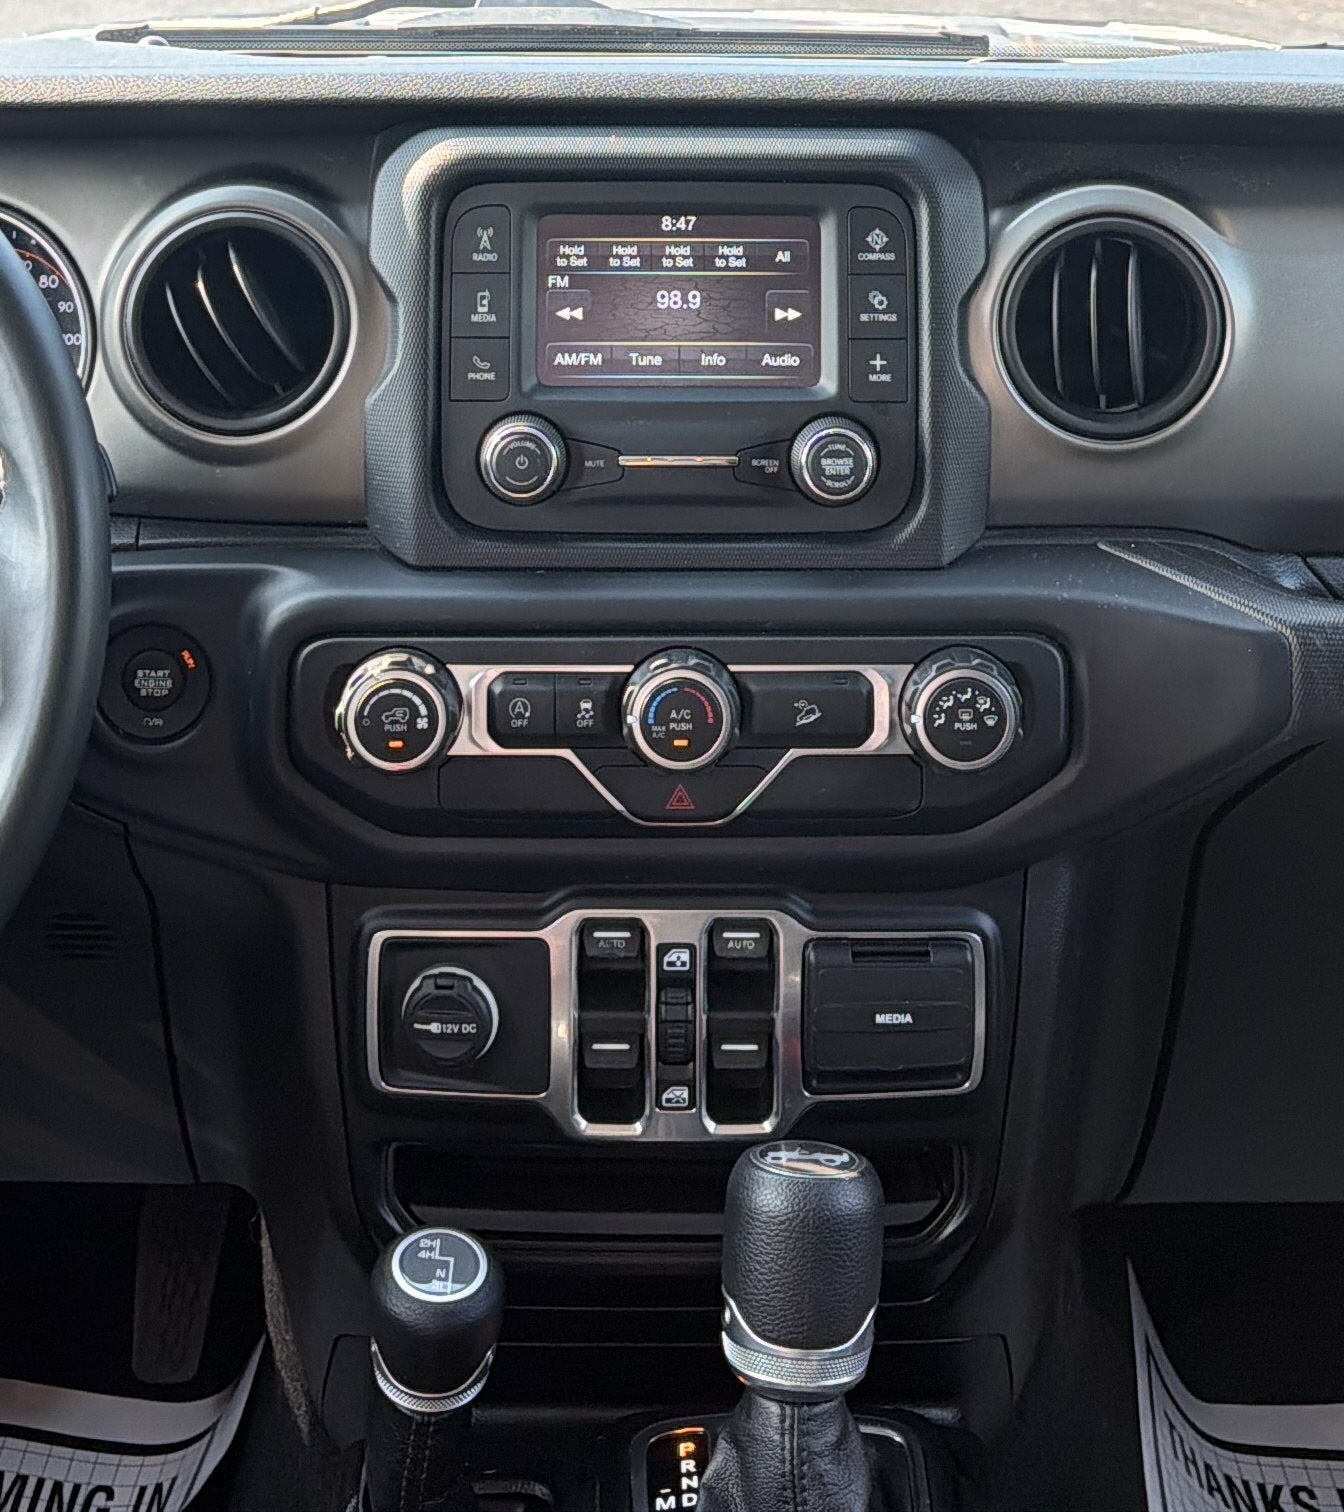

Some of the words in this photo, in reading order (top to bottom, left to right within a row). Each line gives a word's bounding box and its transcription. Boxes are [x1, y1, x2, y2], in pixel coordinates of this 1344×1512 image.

[661, 216, 697, 231] 8:47
[559, 244, 585, 255] Hold
[612, 244, 638, 255] Hold
[665, 244, 691, 255] Hold
[718, 244, 744, 255] Hold
[472, 252, 498, 262] RADIO
[775, 250, 791, 263] All
[857, 252, 896, 261] COMPASS
[556, 257, 568, 267] to
[569, 257, 588, 267] Set
[609, 257, 621, 267] to
[622, 257, 641, 267] Set
[662, 257, 674, 267] to
[675, 257, 694, 267] Set
[715, 257, 727, 267] to
[728, 257, 747, 267] Set
[38, 275, 59, 289] 80
[547, 275, 570, 288] FM
[656, 290, 701, 310] 98.9
[57, 301, 74, 313] 90
[470, 313, 497, 323] MEDIA
[859, 313, 897, 322] SETTINGS
[553, 354, 603, 367] AM/FM
[629, 353, 663, 367] Tune
[700, 353, 726, 367] Info
[761, 353, 801, 367] Audio
[467, 372, 497, 381] PHONE
[868, 374, 893, 382] MORE
[508, 441, 536, 450] VOLUME
[828, 443, 847, 451] TUNE
[584, 459, 606, 468] MUTE
[751, 458, 780, 467] SCREEN
[820, 458, 854, 466] BROWSE
[764, 466, 779, 474] OFF
[825, 467, 851, 476] ENTER
[136, 669, 171, 678] START
[134, 678, 173, 688] ENGINE
[139, 688, 169, 697] STOP
[669, 709, 692, 720] A/C
[384, 723, 408, 733] PUSH
[510, 718, 529, 728] OFF
[576, 718, 595, 728] OFF
[669, 722, 693, 731] PUSH
[954, 722, 978, 731] PUSH
[598, 939, 626, 950] AUTO
[727, 940, 756, 950] AUTO
[875, 1013, 914, 1024] MEDIA
[441, 1023, 460, 1034] 12V
[460, 1023, 478, 1034] DC
[418, 1238, 437, 1249] 2H
[416, 1249, 436, 1260] 4H
[436, 1268, 447, 1278] N
[679, 1441, 697, 1458] P
[680, 1459, 698, 1474] R
[681, 1475, 699, 1490] N
[655, 1495, 676, 1511] M
[682, 1492, 698, 1507] D
